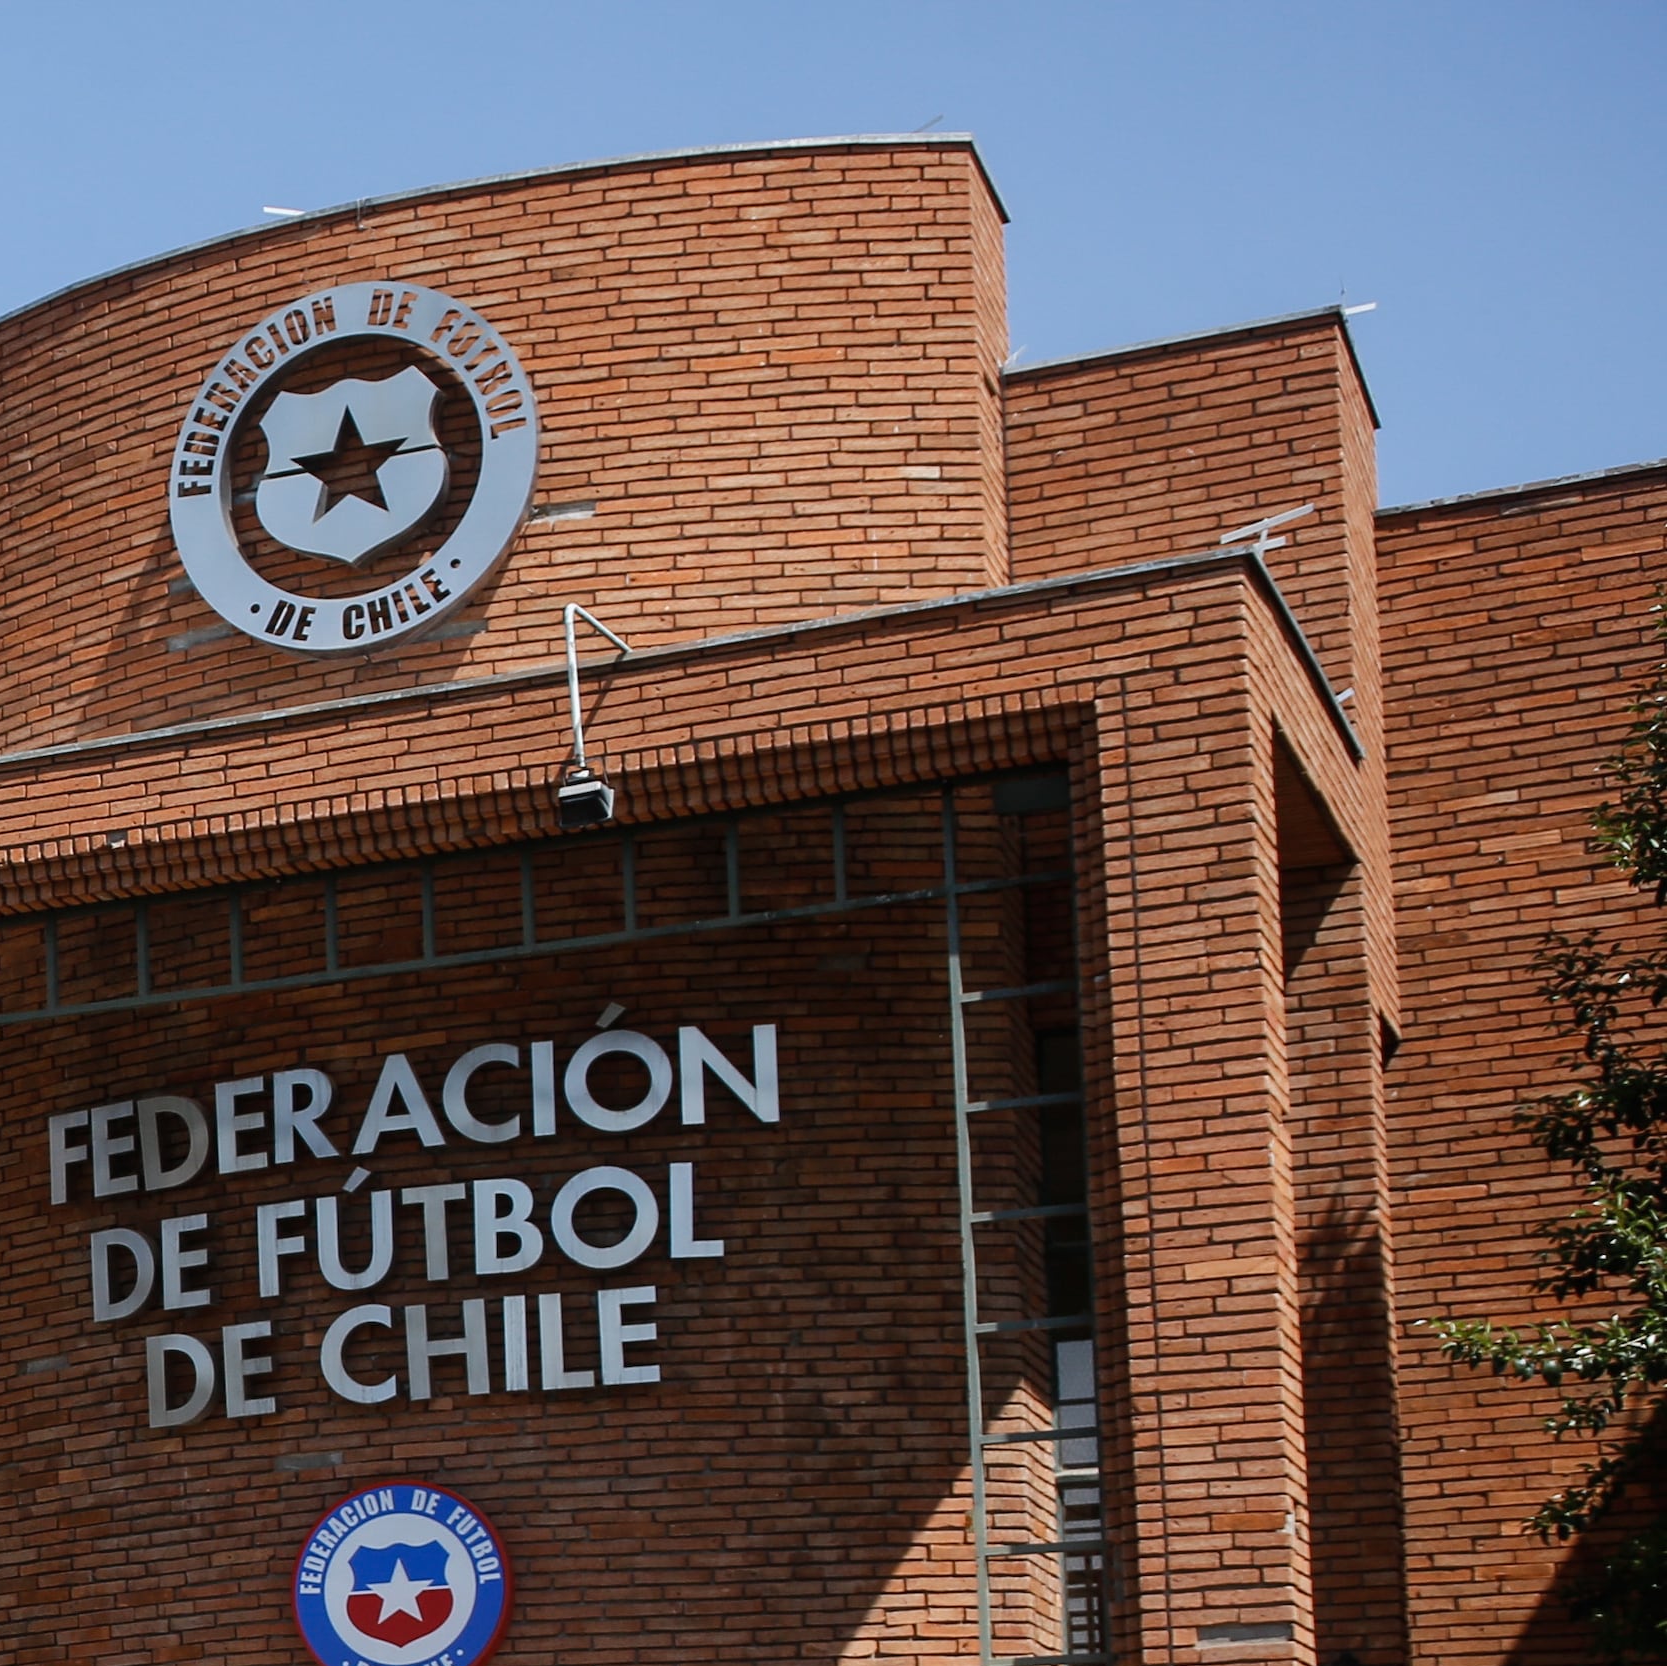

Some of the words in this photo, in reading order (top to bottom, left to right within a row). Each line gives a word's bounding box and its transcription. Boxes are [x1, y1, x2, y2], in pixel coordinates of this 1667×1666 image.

[178, 296, 337, 497] FEDERACION
[367, 288, 419, 330] DE
[429, 308, 527, 440] FUTBOL
[265, 599, 317, 641] DE
[342, 567, 452, 640] CHILE
[48, 1002, 781, 1205] FEDERACIÓN
[90, 1212, 212, 1322] DE
[257, 1161, 725, 1299] FÚTBOL
[145, 1320, 277, 1428] DE
[320, 1285, 662, 1403] CHILE
[299, 1489, 395, 1595] FEDERACION
[410, 1488, 441, 1515] DE
[446, 1505, 501, 1585] FUTBOL
